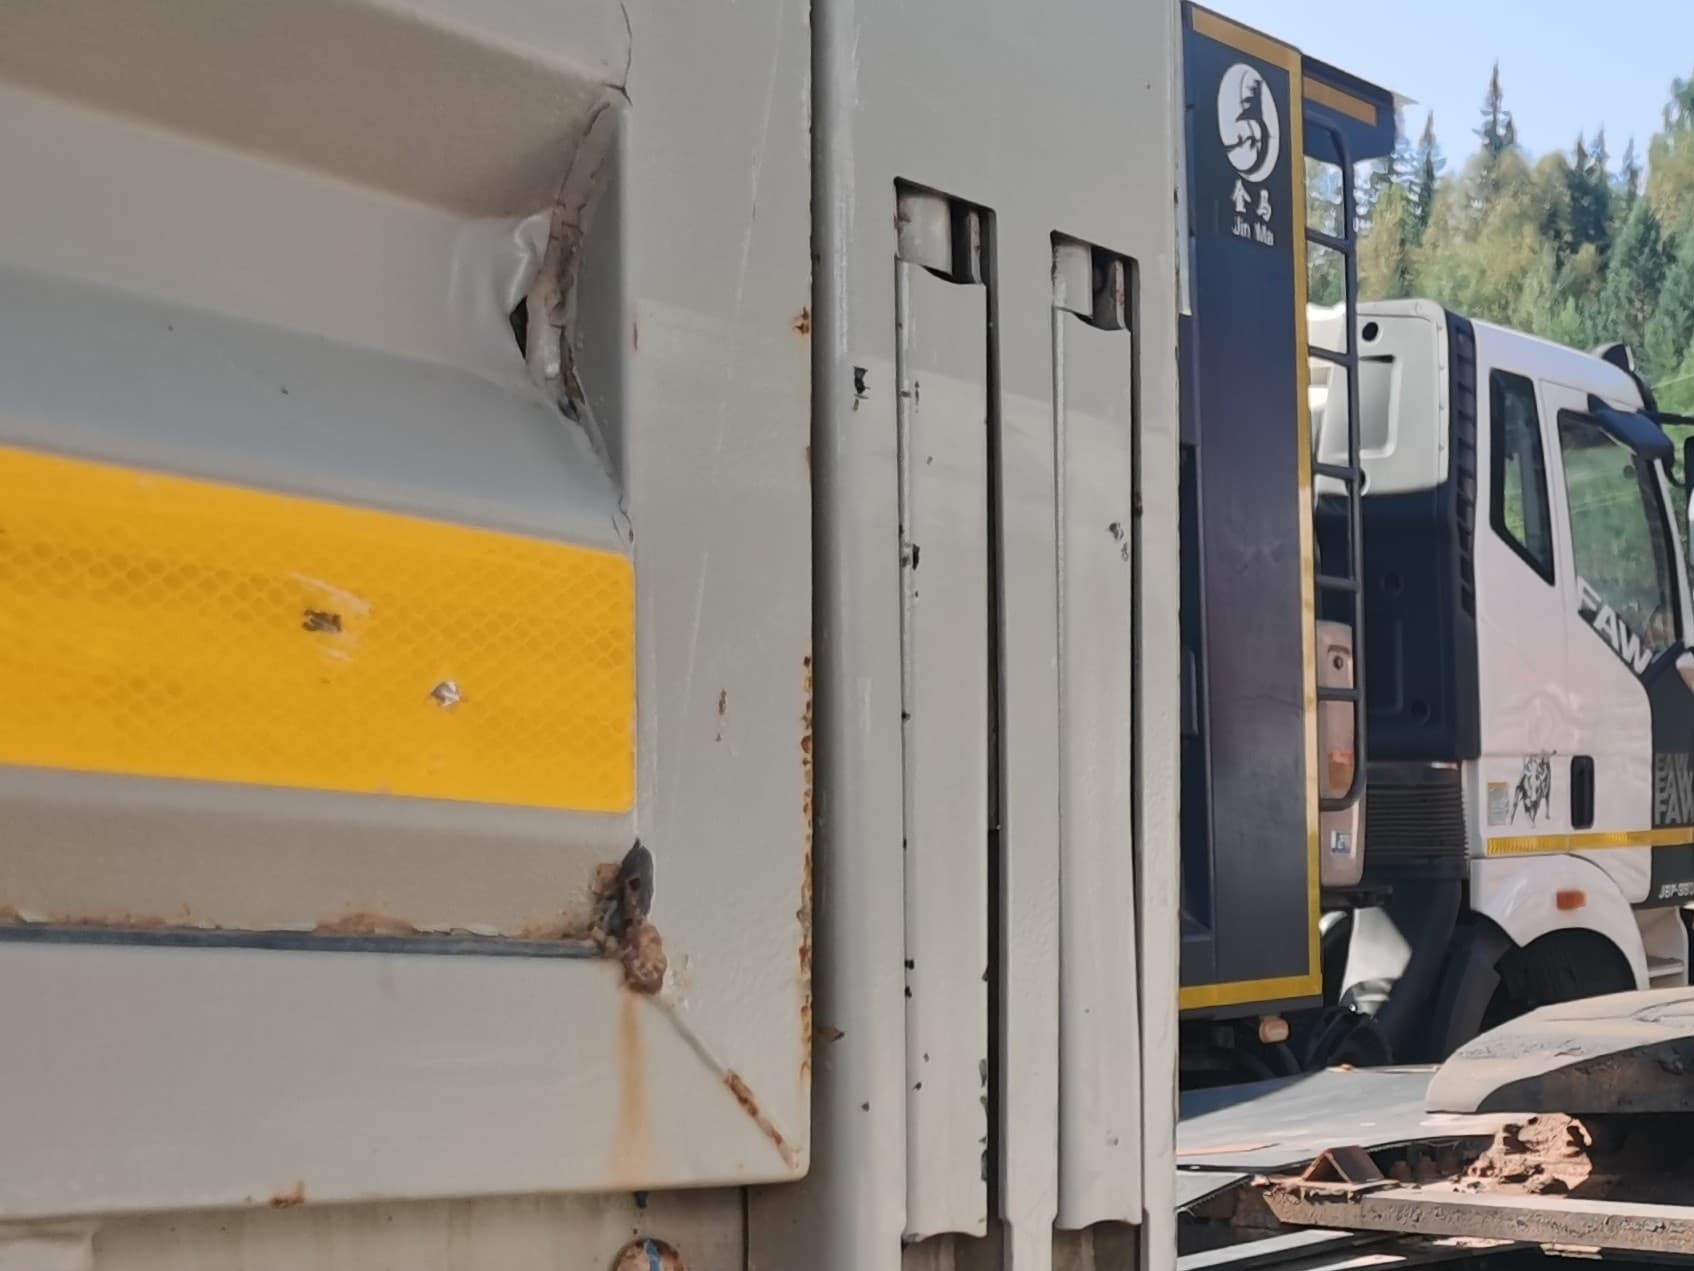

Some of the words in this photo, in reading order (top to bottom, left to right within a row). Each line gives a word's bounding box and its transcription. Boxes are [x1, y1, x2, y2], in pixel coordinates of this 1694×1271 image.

[1232, 215, 1251, 240] Jin
[1255, 221, 1274, 247] Ma
[1577, 575, 1653, 675] FAW
